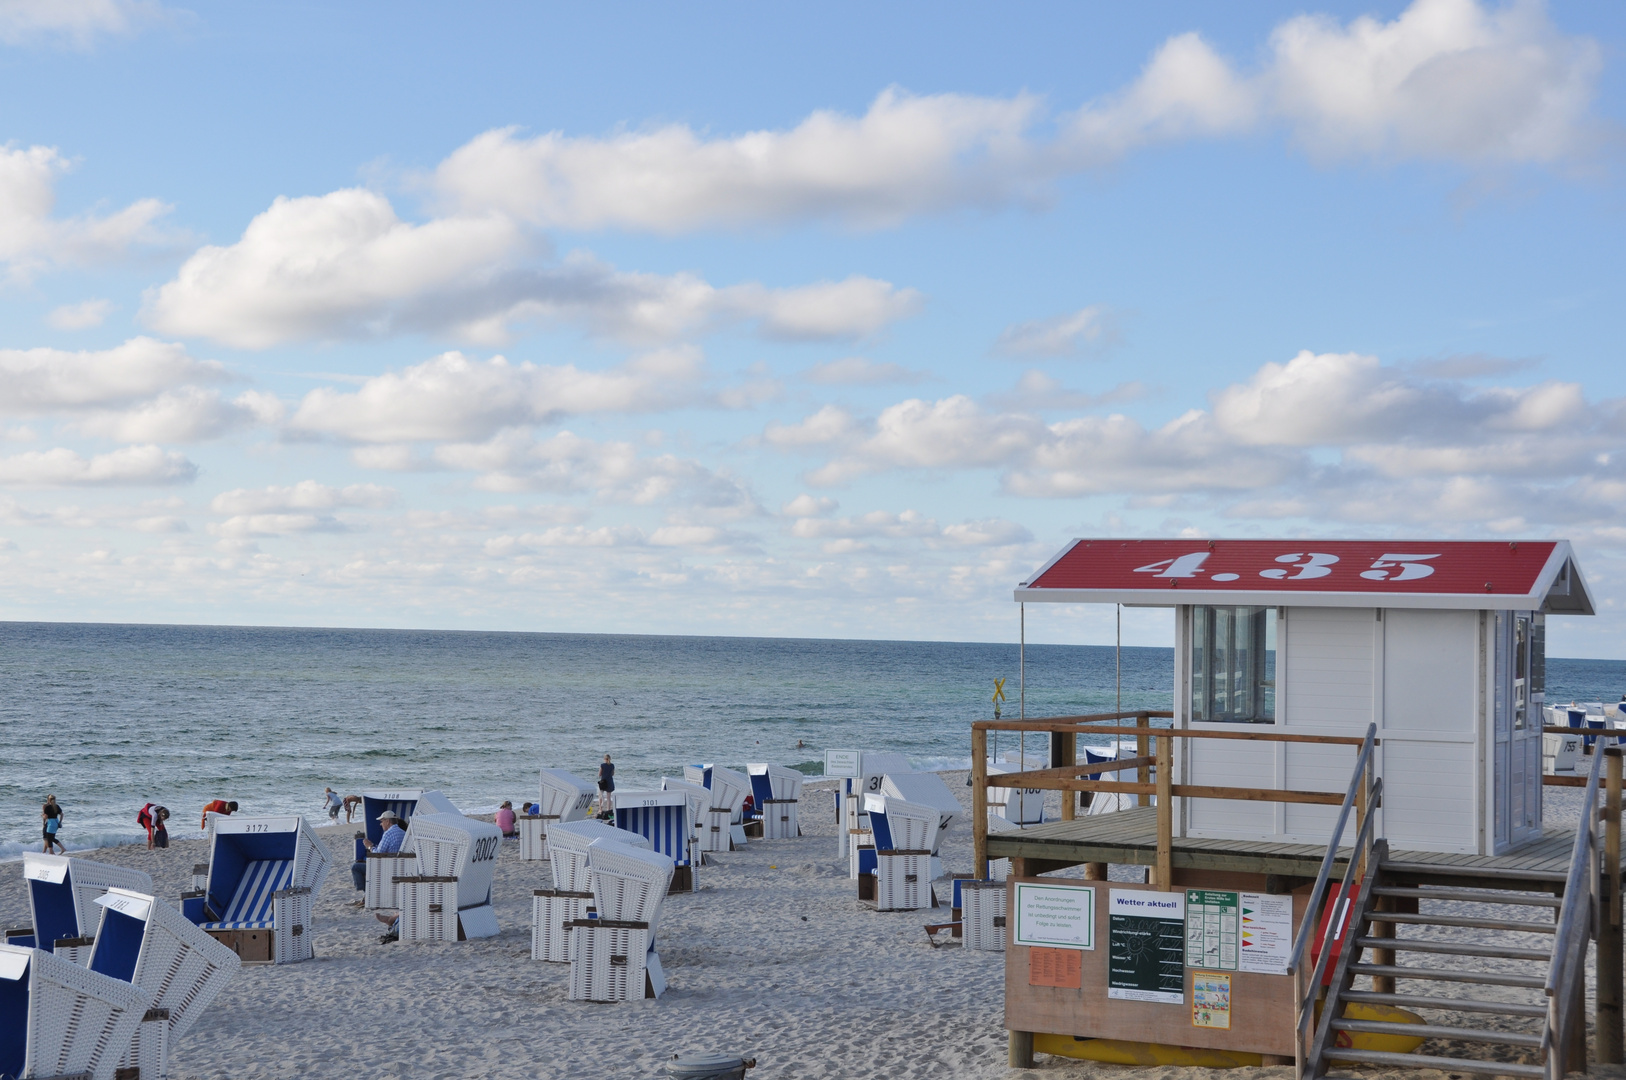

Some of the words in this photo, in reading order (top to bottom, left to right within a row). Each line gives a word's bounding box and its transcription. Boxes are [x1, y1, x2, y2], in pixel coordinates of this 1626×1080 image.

[245, 824, 269, 832] 3172
[472, 836, 498, 863] 3002
[110, 899, 130, 911] 3162
[1045, 896, 1075, 904] Anordnungen
[1117, 898, 1145, 906] Wetter
[1147, 900, 1177, 908] aktuell
